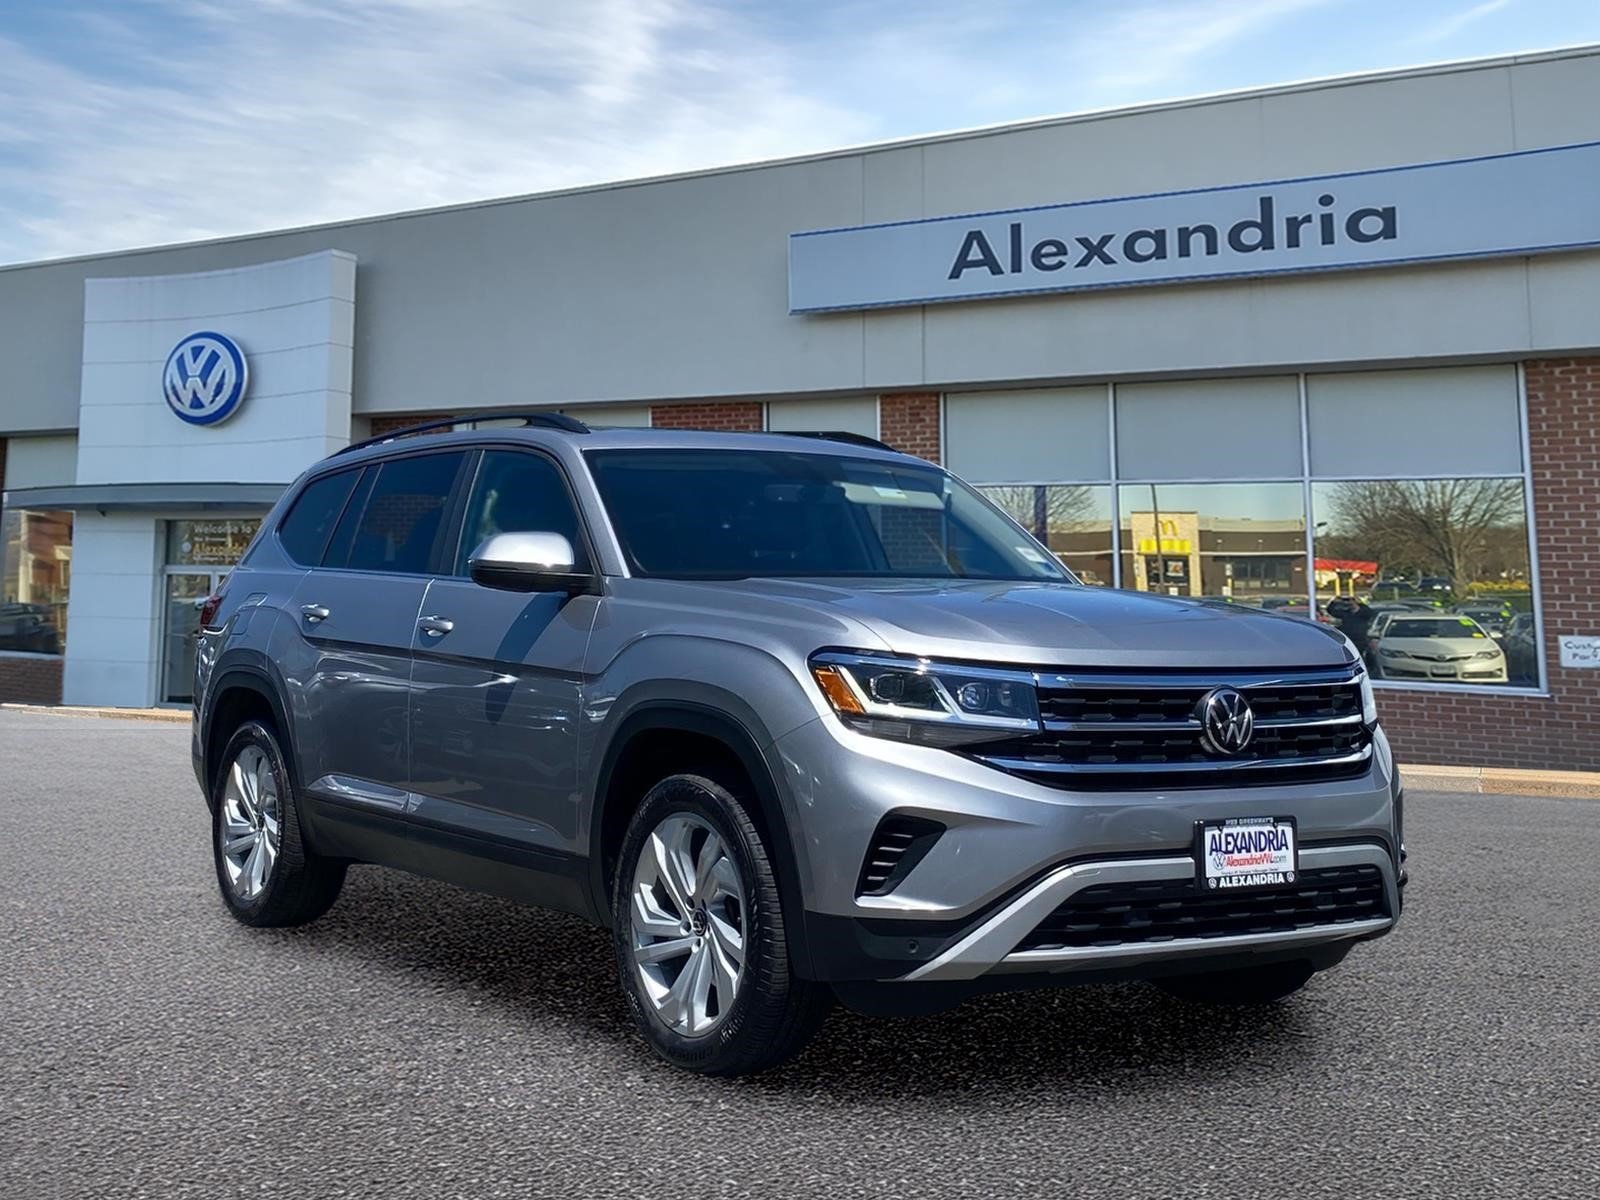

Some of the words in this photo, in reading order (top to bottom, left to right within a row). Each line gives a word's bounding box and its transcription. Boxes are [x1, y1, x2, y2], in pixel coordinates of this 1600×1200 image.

[948, 194, 1398, 280] Alexandria
[1209, 830, 1289, 856] ALEXANDRIA
[1219, 873, 1285, 888] ALEXANDRIA
